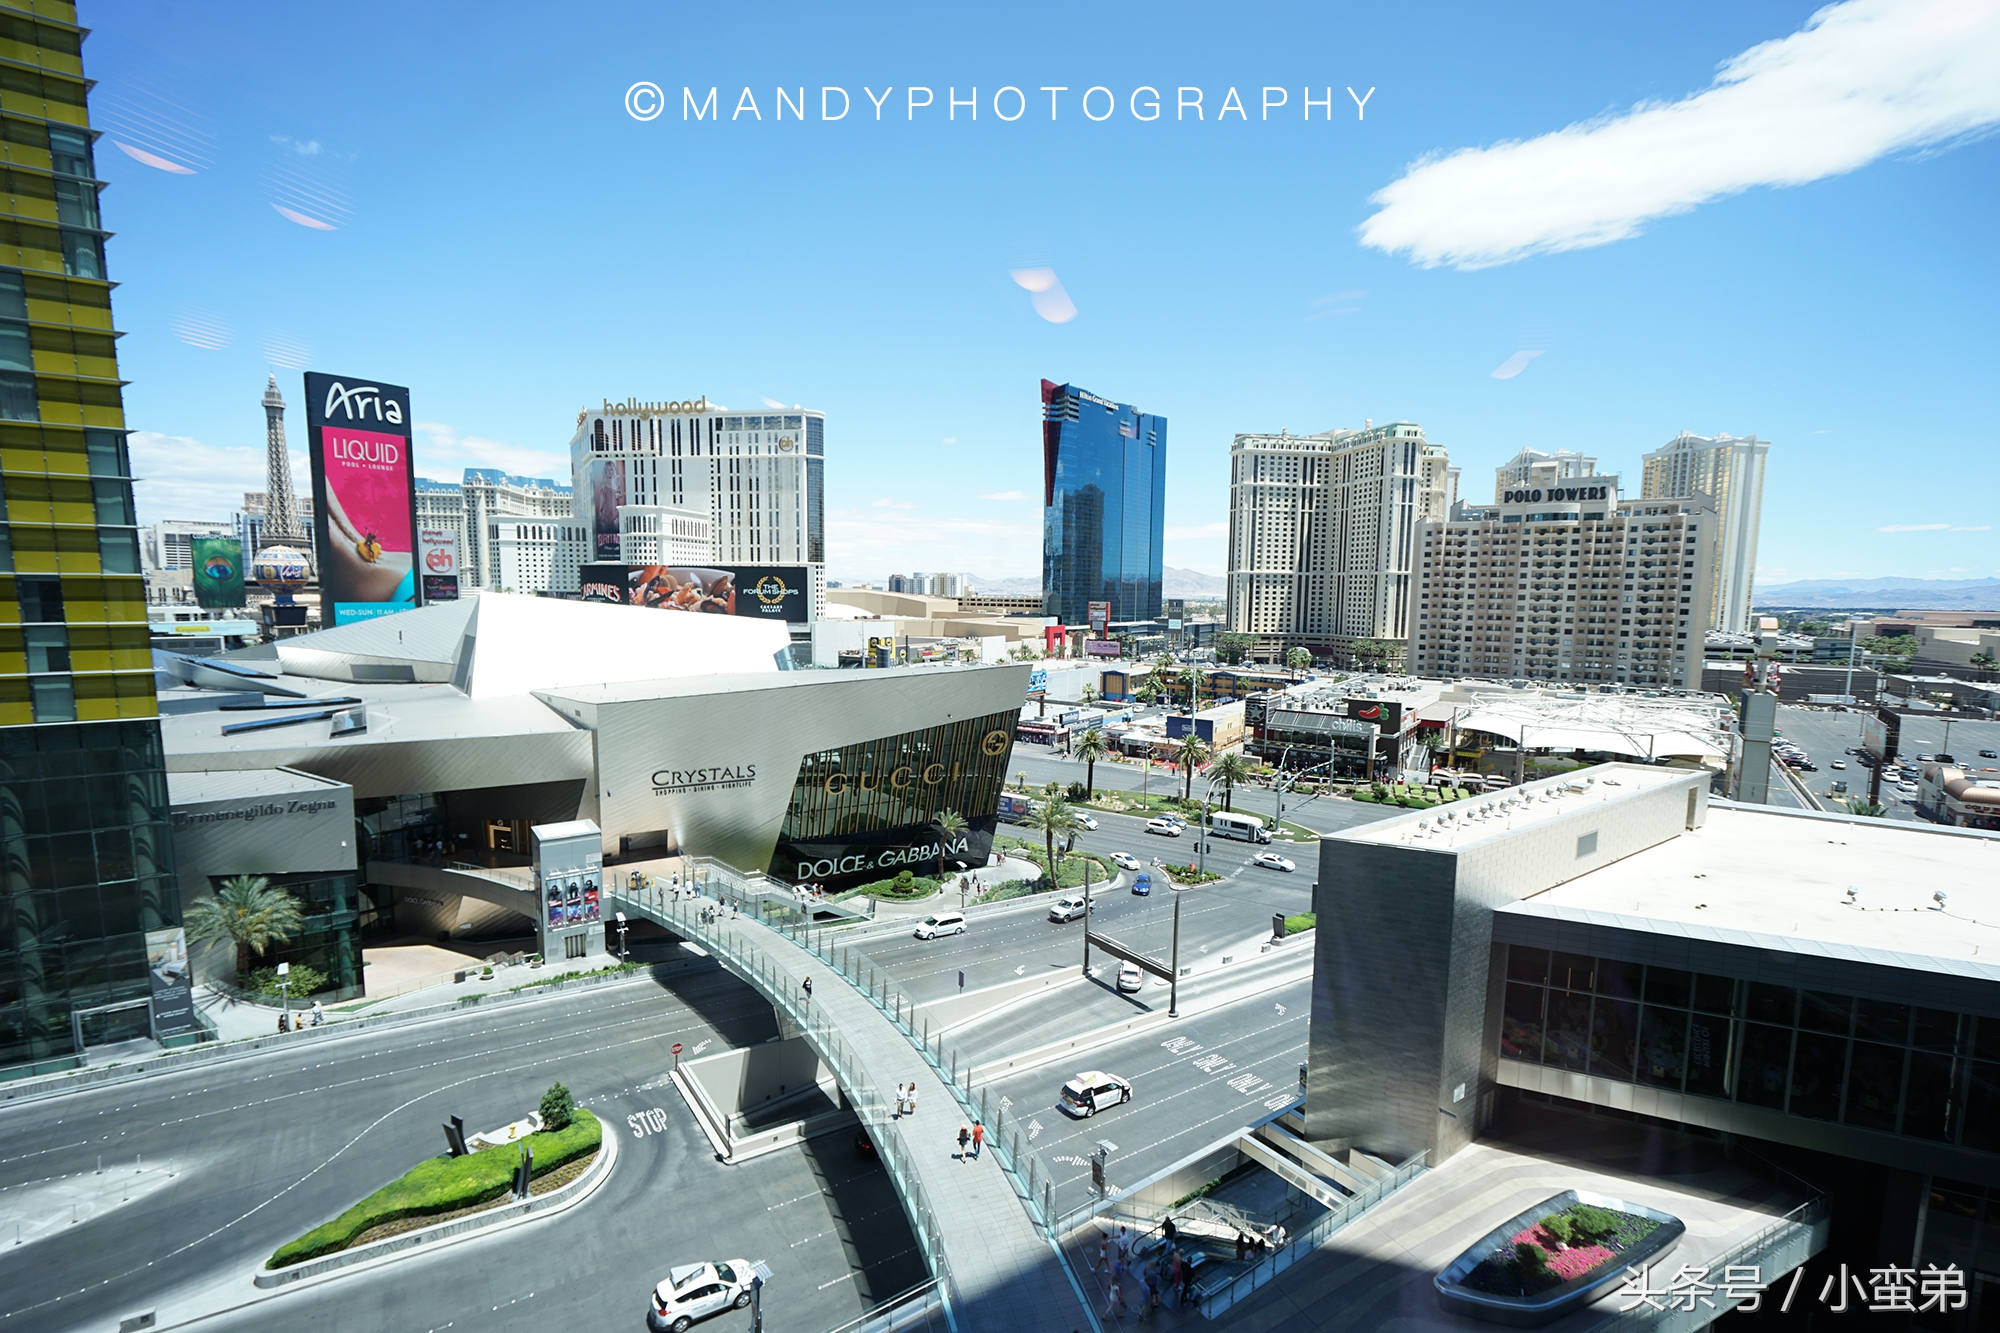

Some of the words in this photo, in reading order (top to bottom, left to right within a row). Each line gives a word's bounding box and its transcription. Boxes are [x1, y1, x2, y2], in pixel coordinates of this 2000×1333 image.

[325, 381, 403, 425] Aria
[603, 395, 706, 421] hollywood
[333, 437, 399, 464] LIQUID
[1504, 489, 1542, 503] POLO
[1547, 486, 1607, 501] TOWERS
[192, 533, 241, 541] COSMOPOLITAN
[421, 529, 443, 537] planet
[421, 537, 454, 546] hollywood
[338, 608, 374, 616] WED-SUN
[376, 608, 383, 616] 11
[651, 764, 757, 787] CRYSTALS
[825, 761, 960, 796] GUCCI
[655, 788, 687, 797] SHOPPING
[693, 785, 715, 793] DINING
[721, 782, 752, 790] NIGHTLIFE
[171, 803, 284, 826] Ermenegildo
[287, 799, 337, 814] Zegna
[798, 855, 866, 881] DOLCE
[866, 859, 875, 870] &
[877, 837, 969, 868] GABBANA
[626, 1107, 668, 1138] STOP
